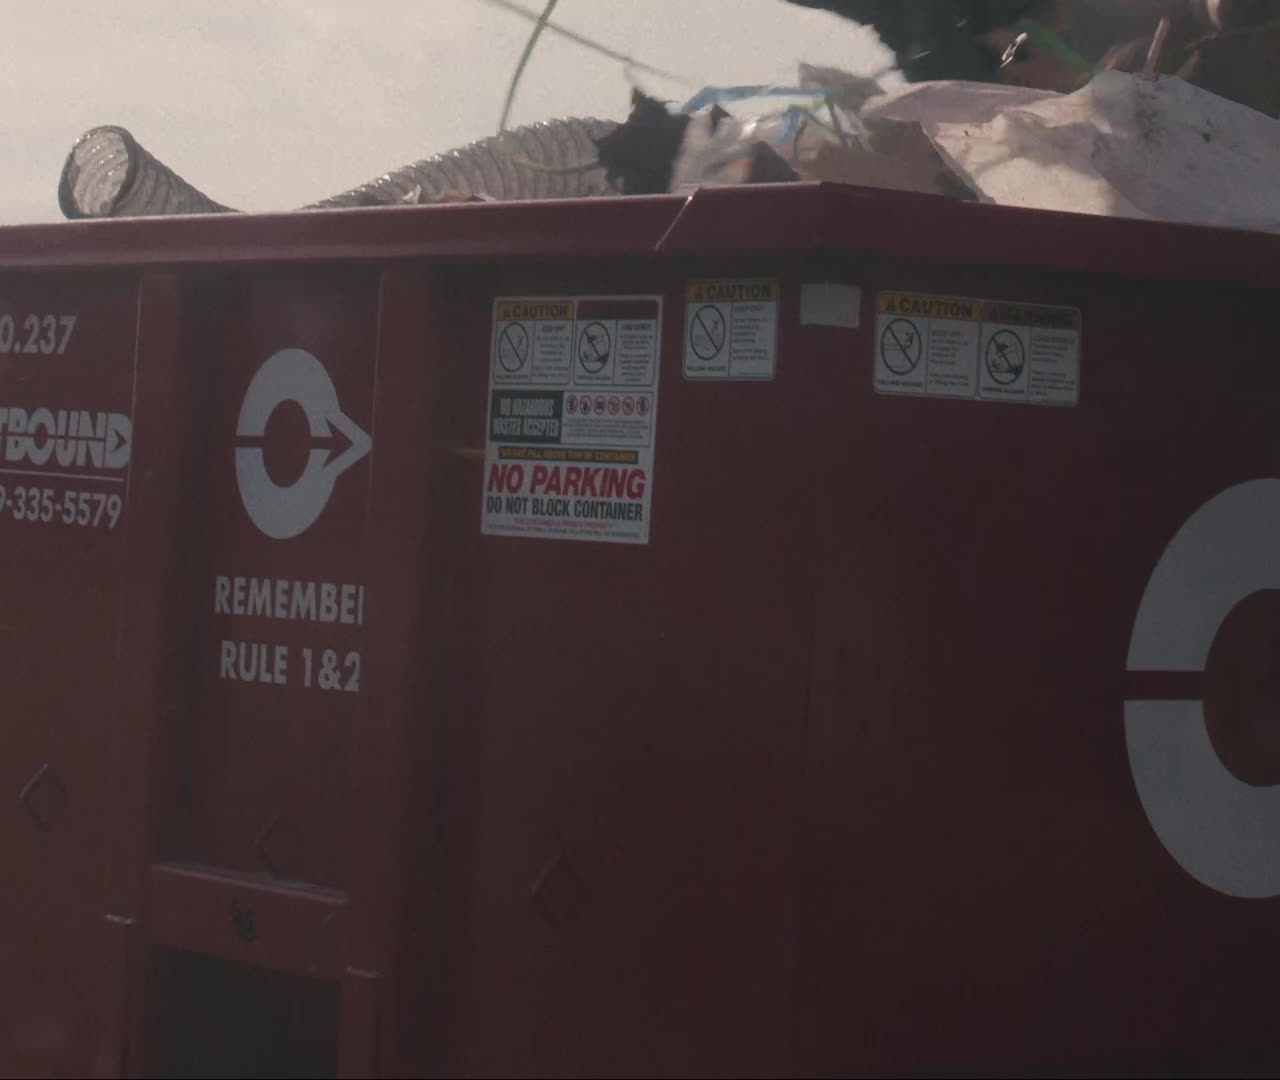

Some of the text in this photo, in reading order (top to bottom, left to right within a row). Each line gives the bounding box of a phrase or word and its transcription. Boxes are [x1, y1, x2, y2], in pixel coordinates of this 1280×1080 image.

[707, 284, 772, 298] CAUTION
[512, 304, 569, 318] CAUTION
[899, 298, 973, 317] CAUTION
[488, 463, 646, 500] NO PARKING
[487, 496, 643, 521] DO NOT BLOCK CONTAINER
[214, 575, 365, 625] REMEMBE
[220, 640, 361, 692] RULE 1&2
